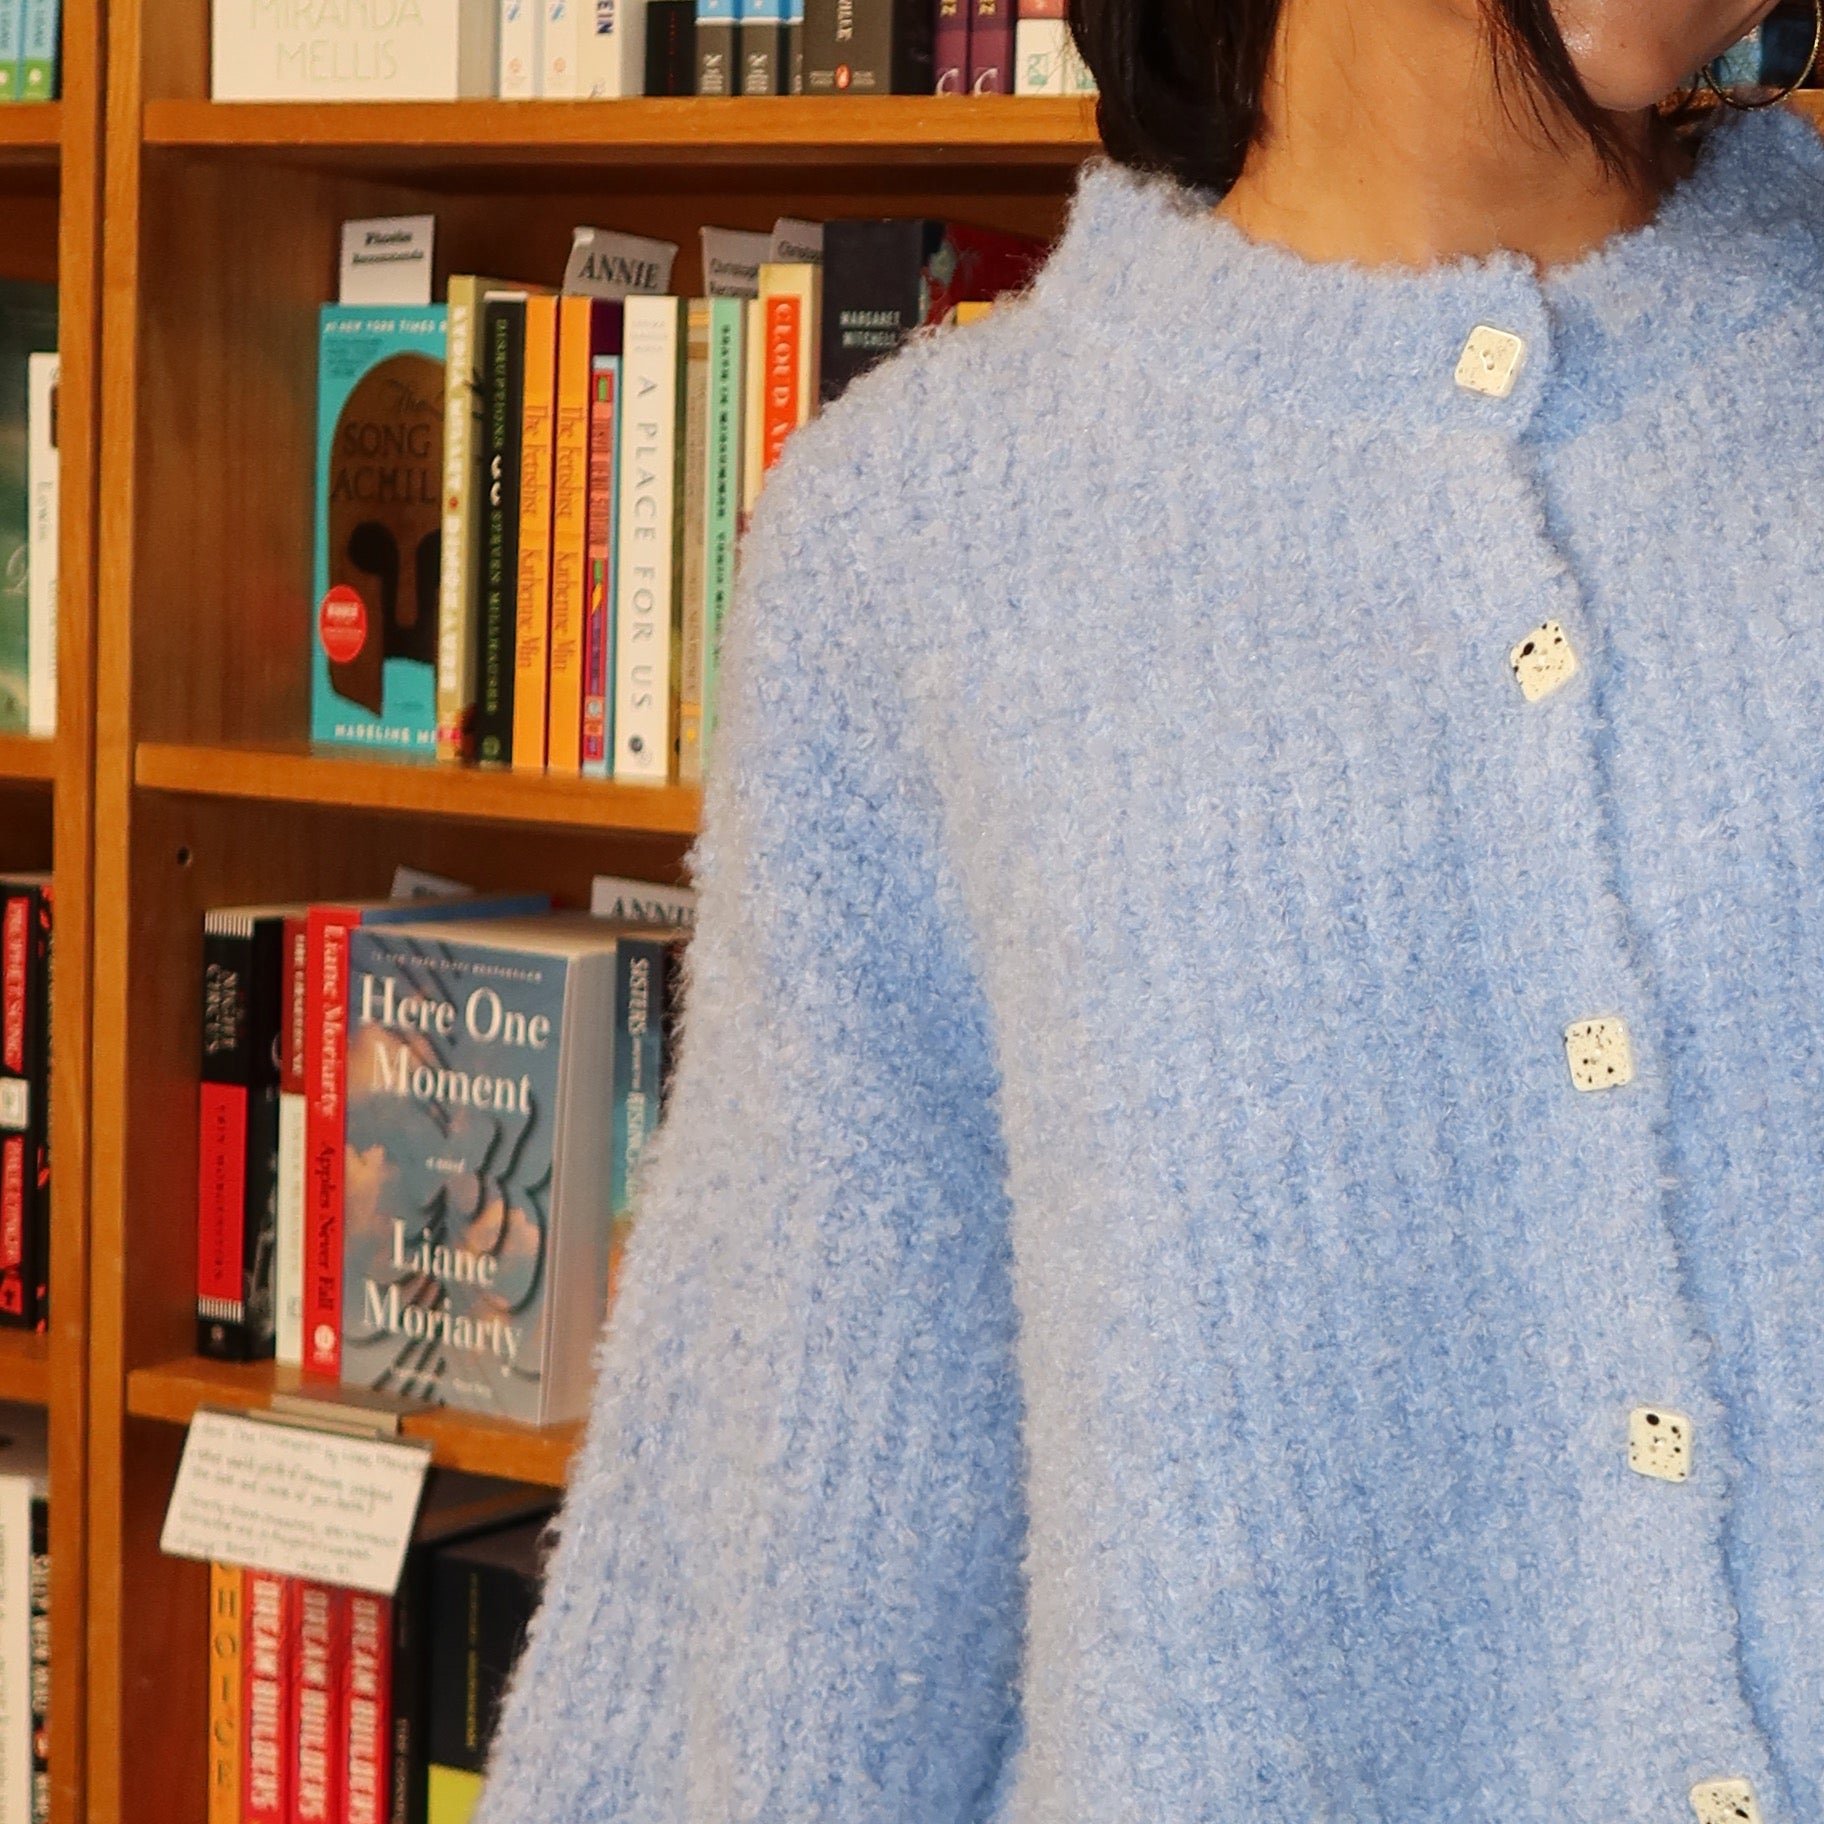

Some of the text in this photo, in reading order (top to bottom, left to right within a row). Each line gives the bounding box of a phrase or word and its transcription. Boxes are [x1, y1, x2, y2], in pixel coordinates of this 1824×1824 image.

[275, 34, 400, 86] MELLIS
[578, 252, 661, 290] ANNIE
[772, 303, 794, 407] CLOUD
[631, 376, 658, 711] A PLACE FOR US
[315, 925, 346, 1119] Liane Moriarty
[361, 973, 551, 1050] Here One
[369, 1043, 532, 1117] Moment
[391, 1218, 498, 1290] Liane
[361, 1279, 521, 1359] Moriarty
